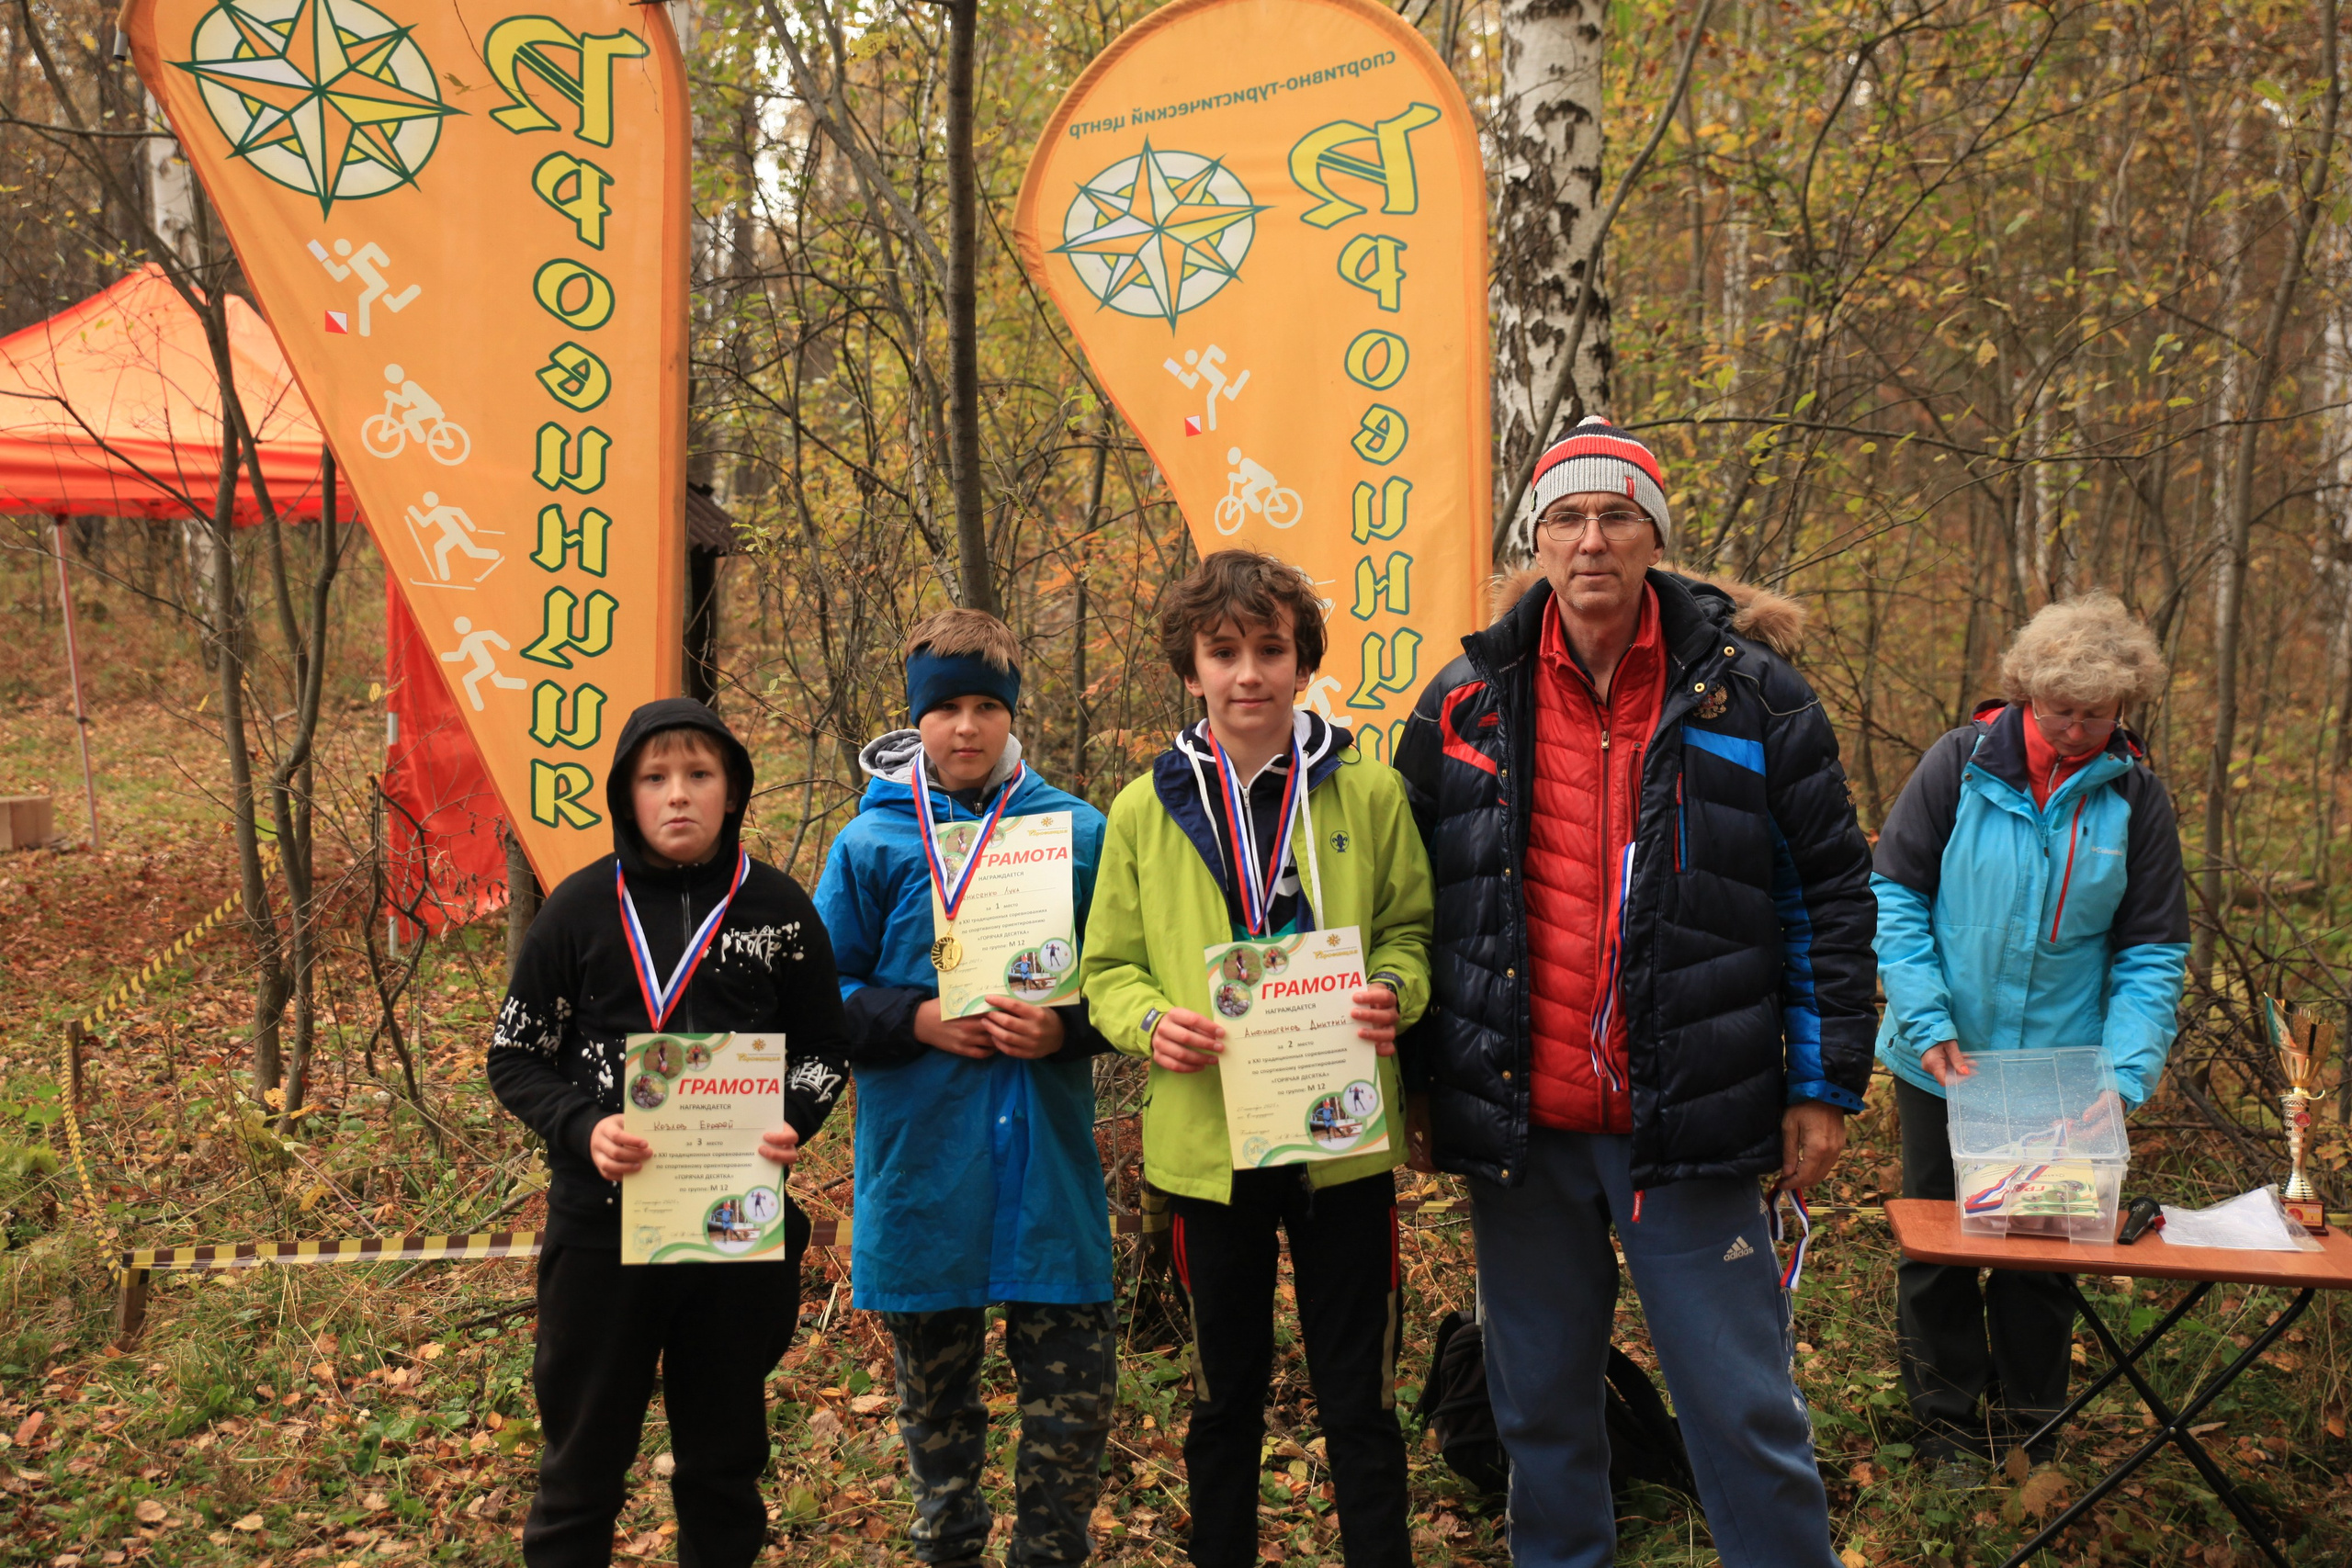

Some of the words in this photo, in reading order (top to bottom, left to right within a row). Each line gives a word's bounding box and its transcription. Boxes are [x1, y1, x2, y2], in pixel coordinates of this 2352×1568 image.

[976, 846, 1069, 869] ГРАМОТА
[978, 871, 1024, 881] НАГРАЖДАЕТСЯ
[968, 924, 1001, 933] спортивному
[1002, 919, 1046, 929] ориентированию
[971, 914, 1008, 923] традиционных
[1261, 971, 1363, 999] ГРАМОТА
[1265, 1003, 1317, 1014] НАГРАЖДАЕТСЯ
[1309, 1015, 1347, 1031] Дмитрий
[1262, 1053, 1304, 1063] традиционных
[1260, 1066, 1296, 1074] спортивному
[1297, 1058, 1346, 1069] ориентированию
[677, 1078, 780, 1095] ГРАМОТА
[679, 1103, 732, 1111] НАГРАЖДАЕТСЯ
[1723, 1246, 1754, 1262] adidas
